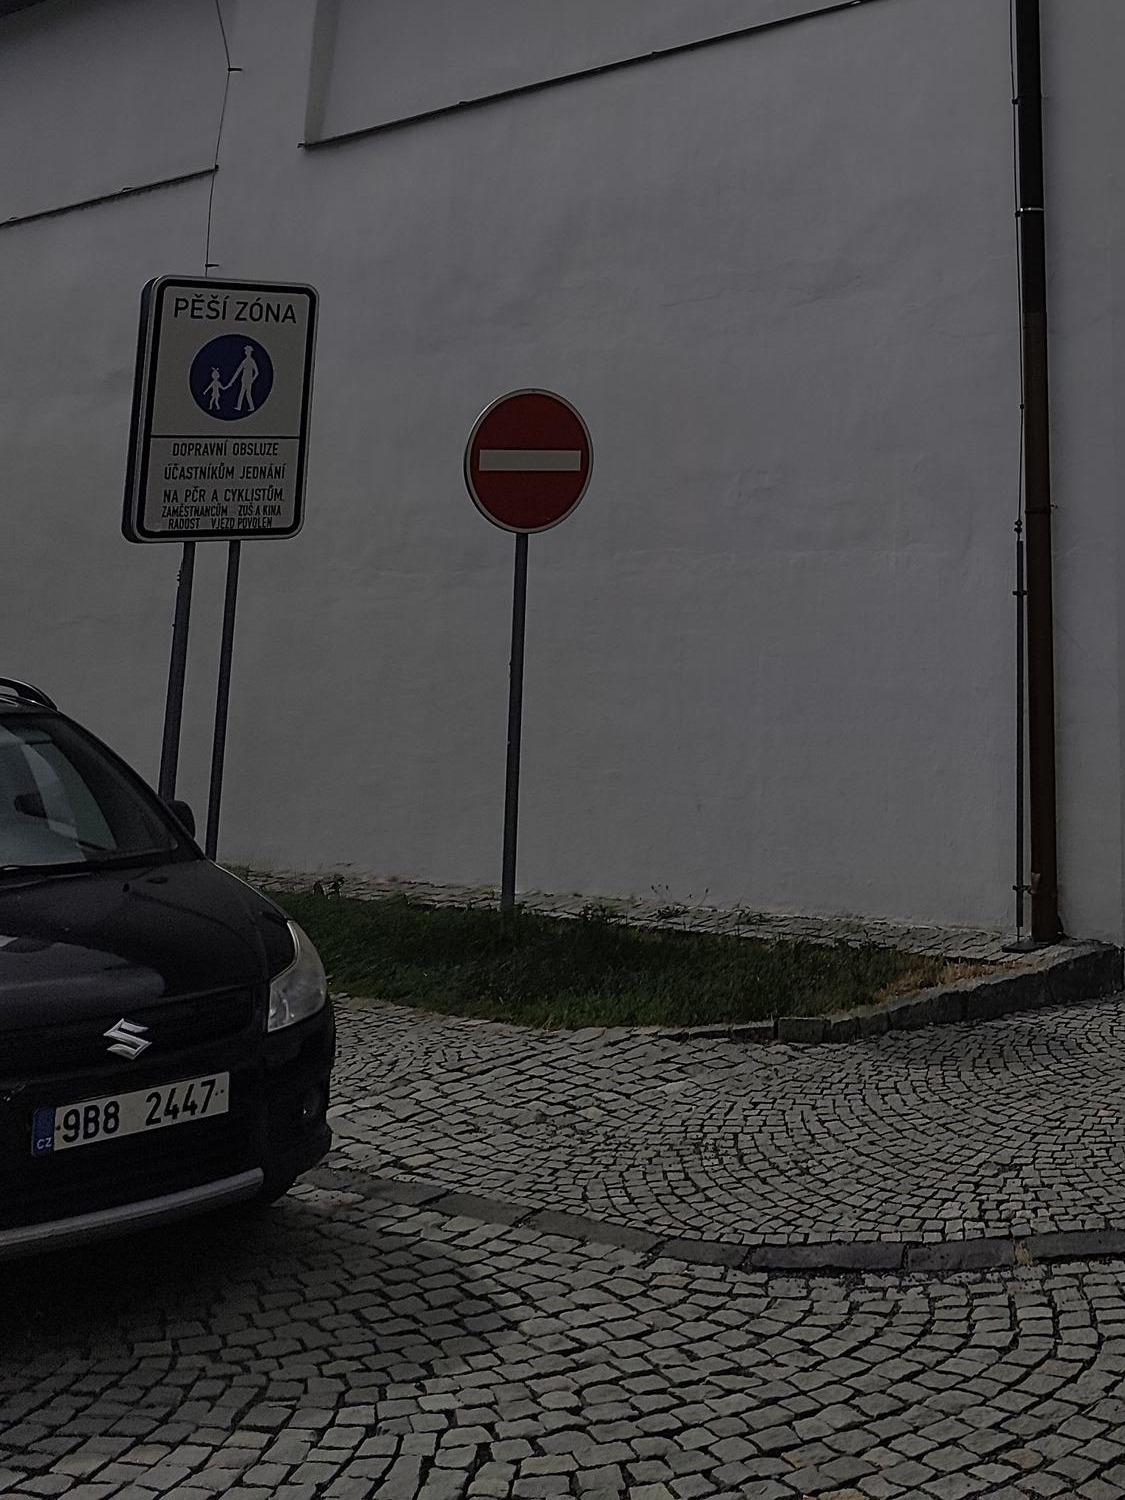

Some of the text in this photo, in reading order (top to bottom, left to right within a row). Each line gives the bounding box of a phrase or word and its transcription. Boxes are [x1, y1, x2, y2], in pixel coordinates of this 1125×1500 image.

[173, 293, 297, 324] PĚŠÍ ZÓNA
[172, 439, 279, 456] DOPRAVNÍ OBSLUZE
[164, 462, 287, 480] ÚČASTNÍKŮM JEDNÁNÍ
[163, 489, 179, 503] NA
[184, 485, 206, 502] PČR
[211, 489, 219, 502] A
[238, 502, 253, 517] ZUŠ
[255, 505, 261, 516] A
[168, 516, 273, 530] RADOST VJEZD POVOLEN
[36, 1078, 217, 1150] CZ 9B8 2447
